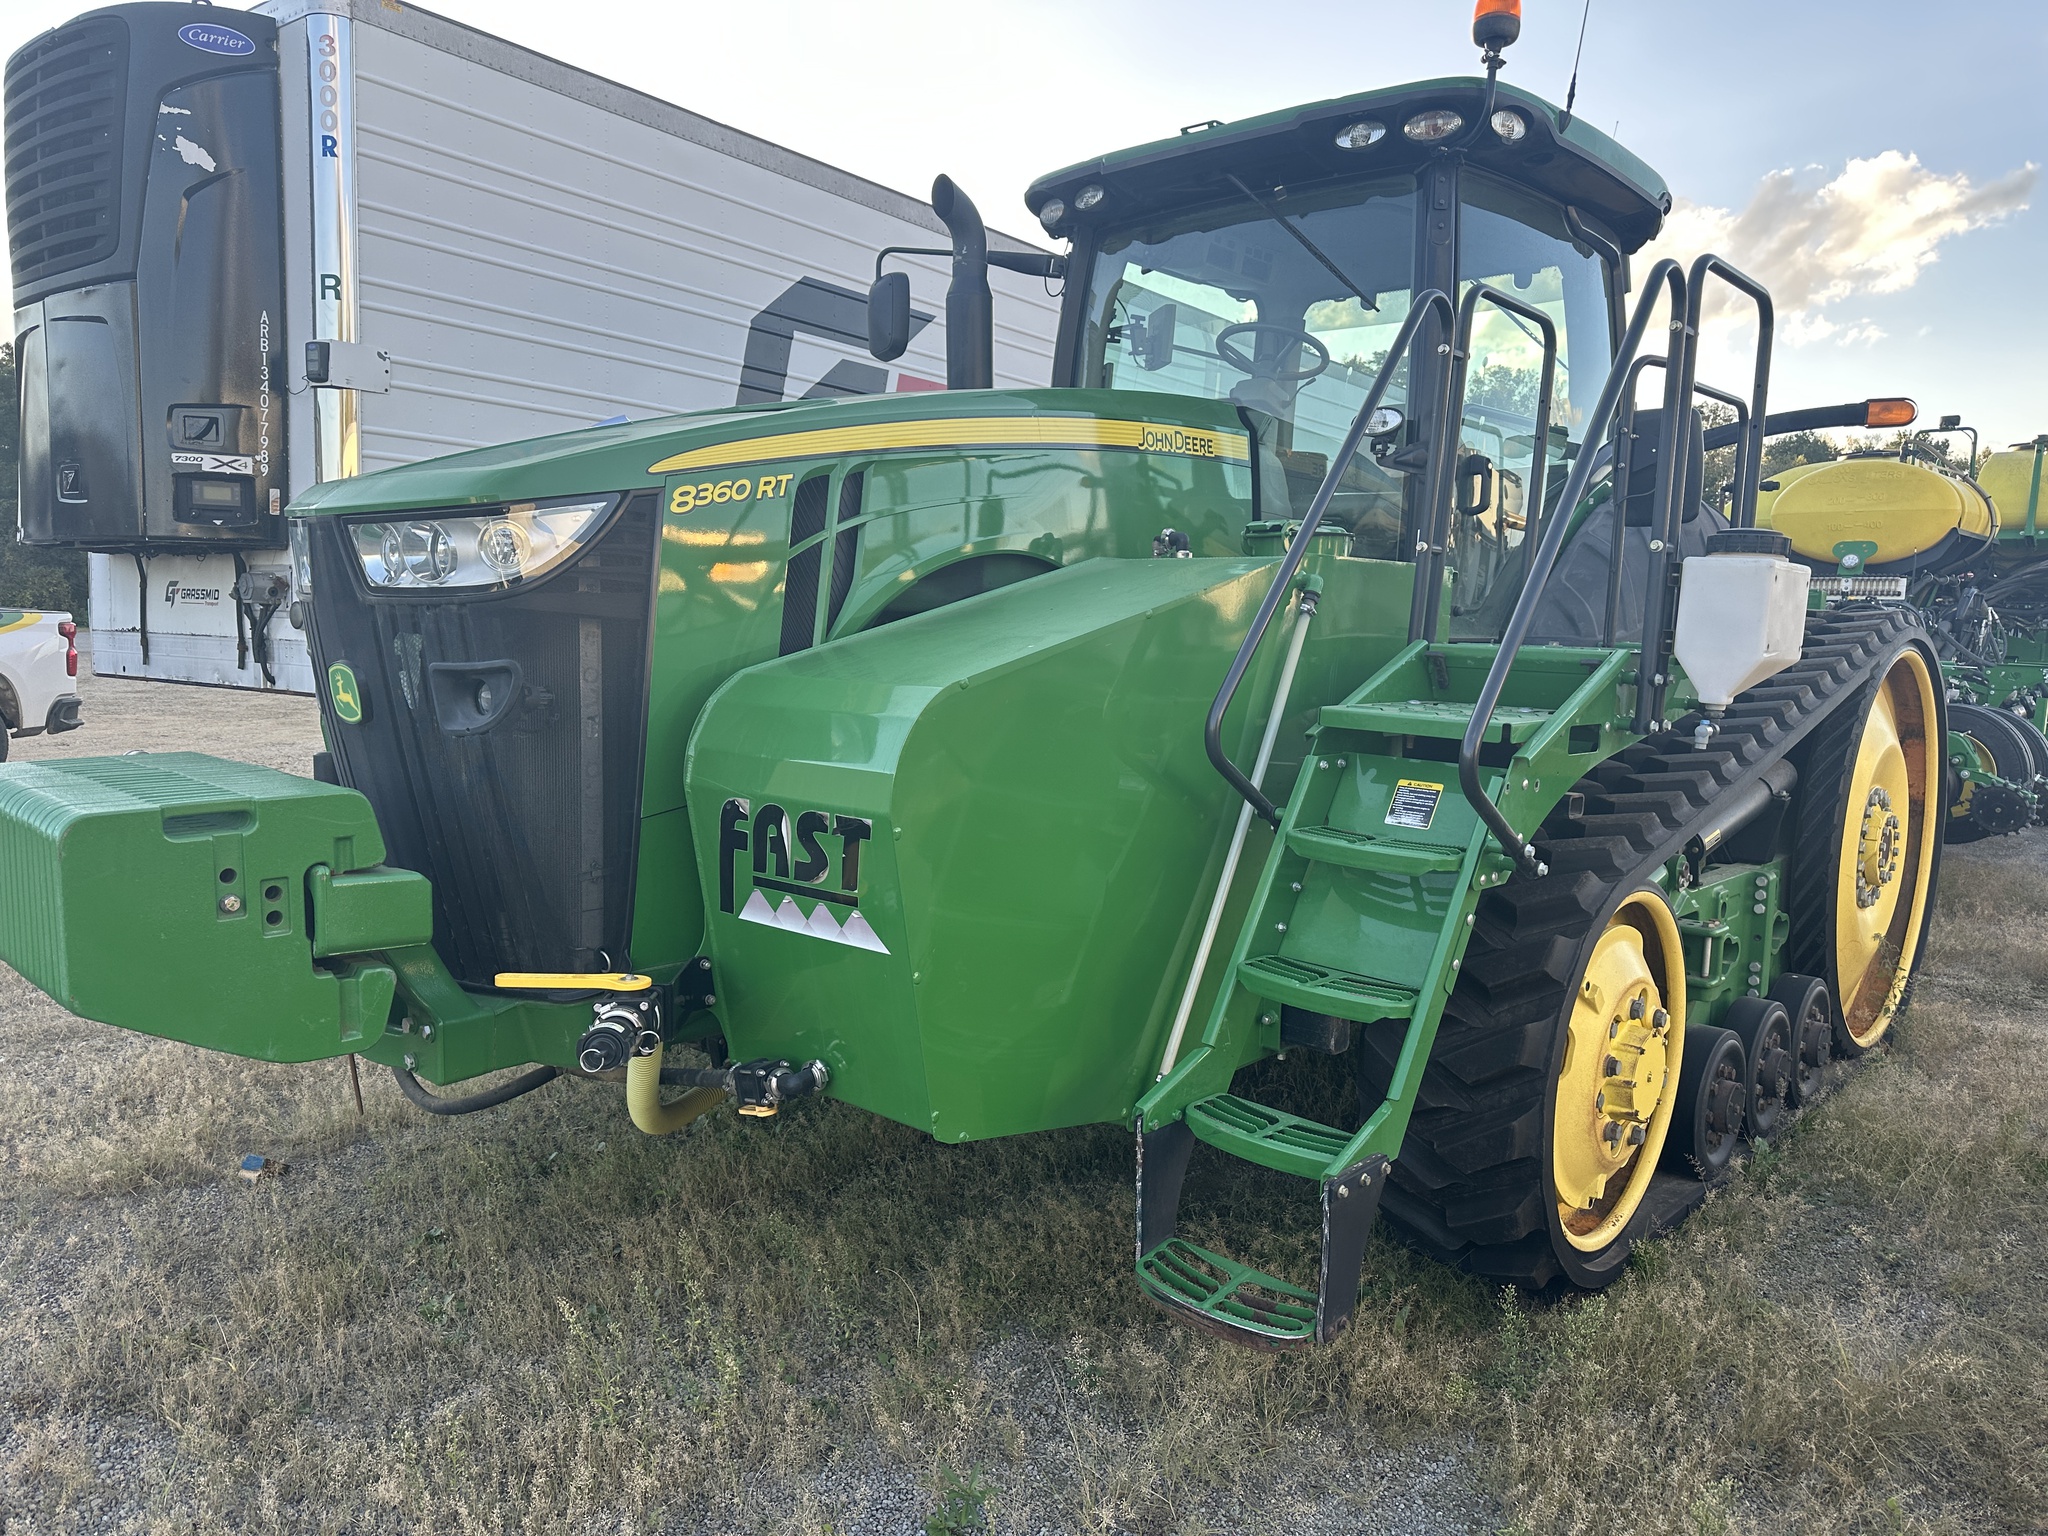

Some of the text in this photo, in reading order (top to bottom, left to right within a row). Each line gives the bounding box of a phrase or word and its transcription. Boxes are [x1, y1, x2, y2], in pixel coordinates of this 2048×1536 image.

[188, 28, 246, 49] Carrier
[320, 273, 342, 301] R
[259, 310, 270, 477] ARB134077989
[174, 455, 204, 463] 7300
[669, 473, 794, 514] 8360 RT
[181, 588, 220, 600] GRASSMID
[719, 797, 873, 915] FAST
